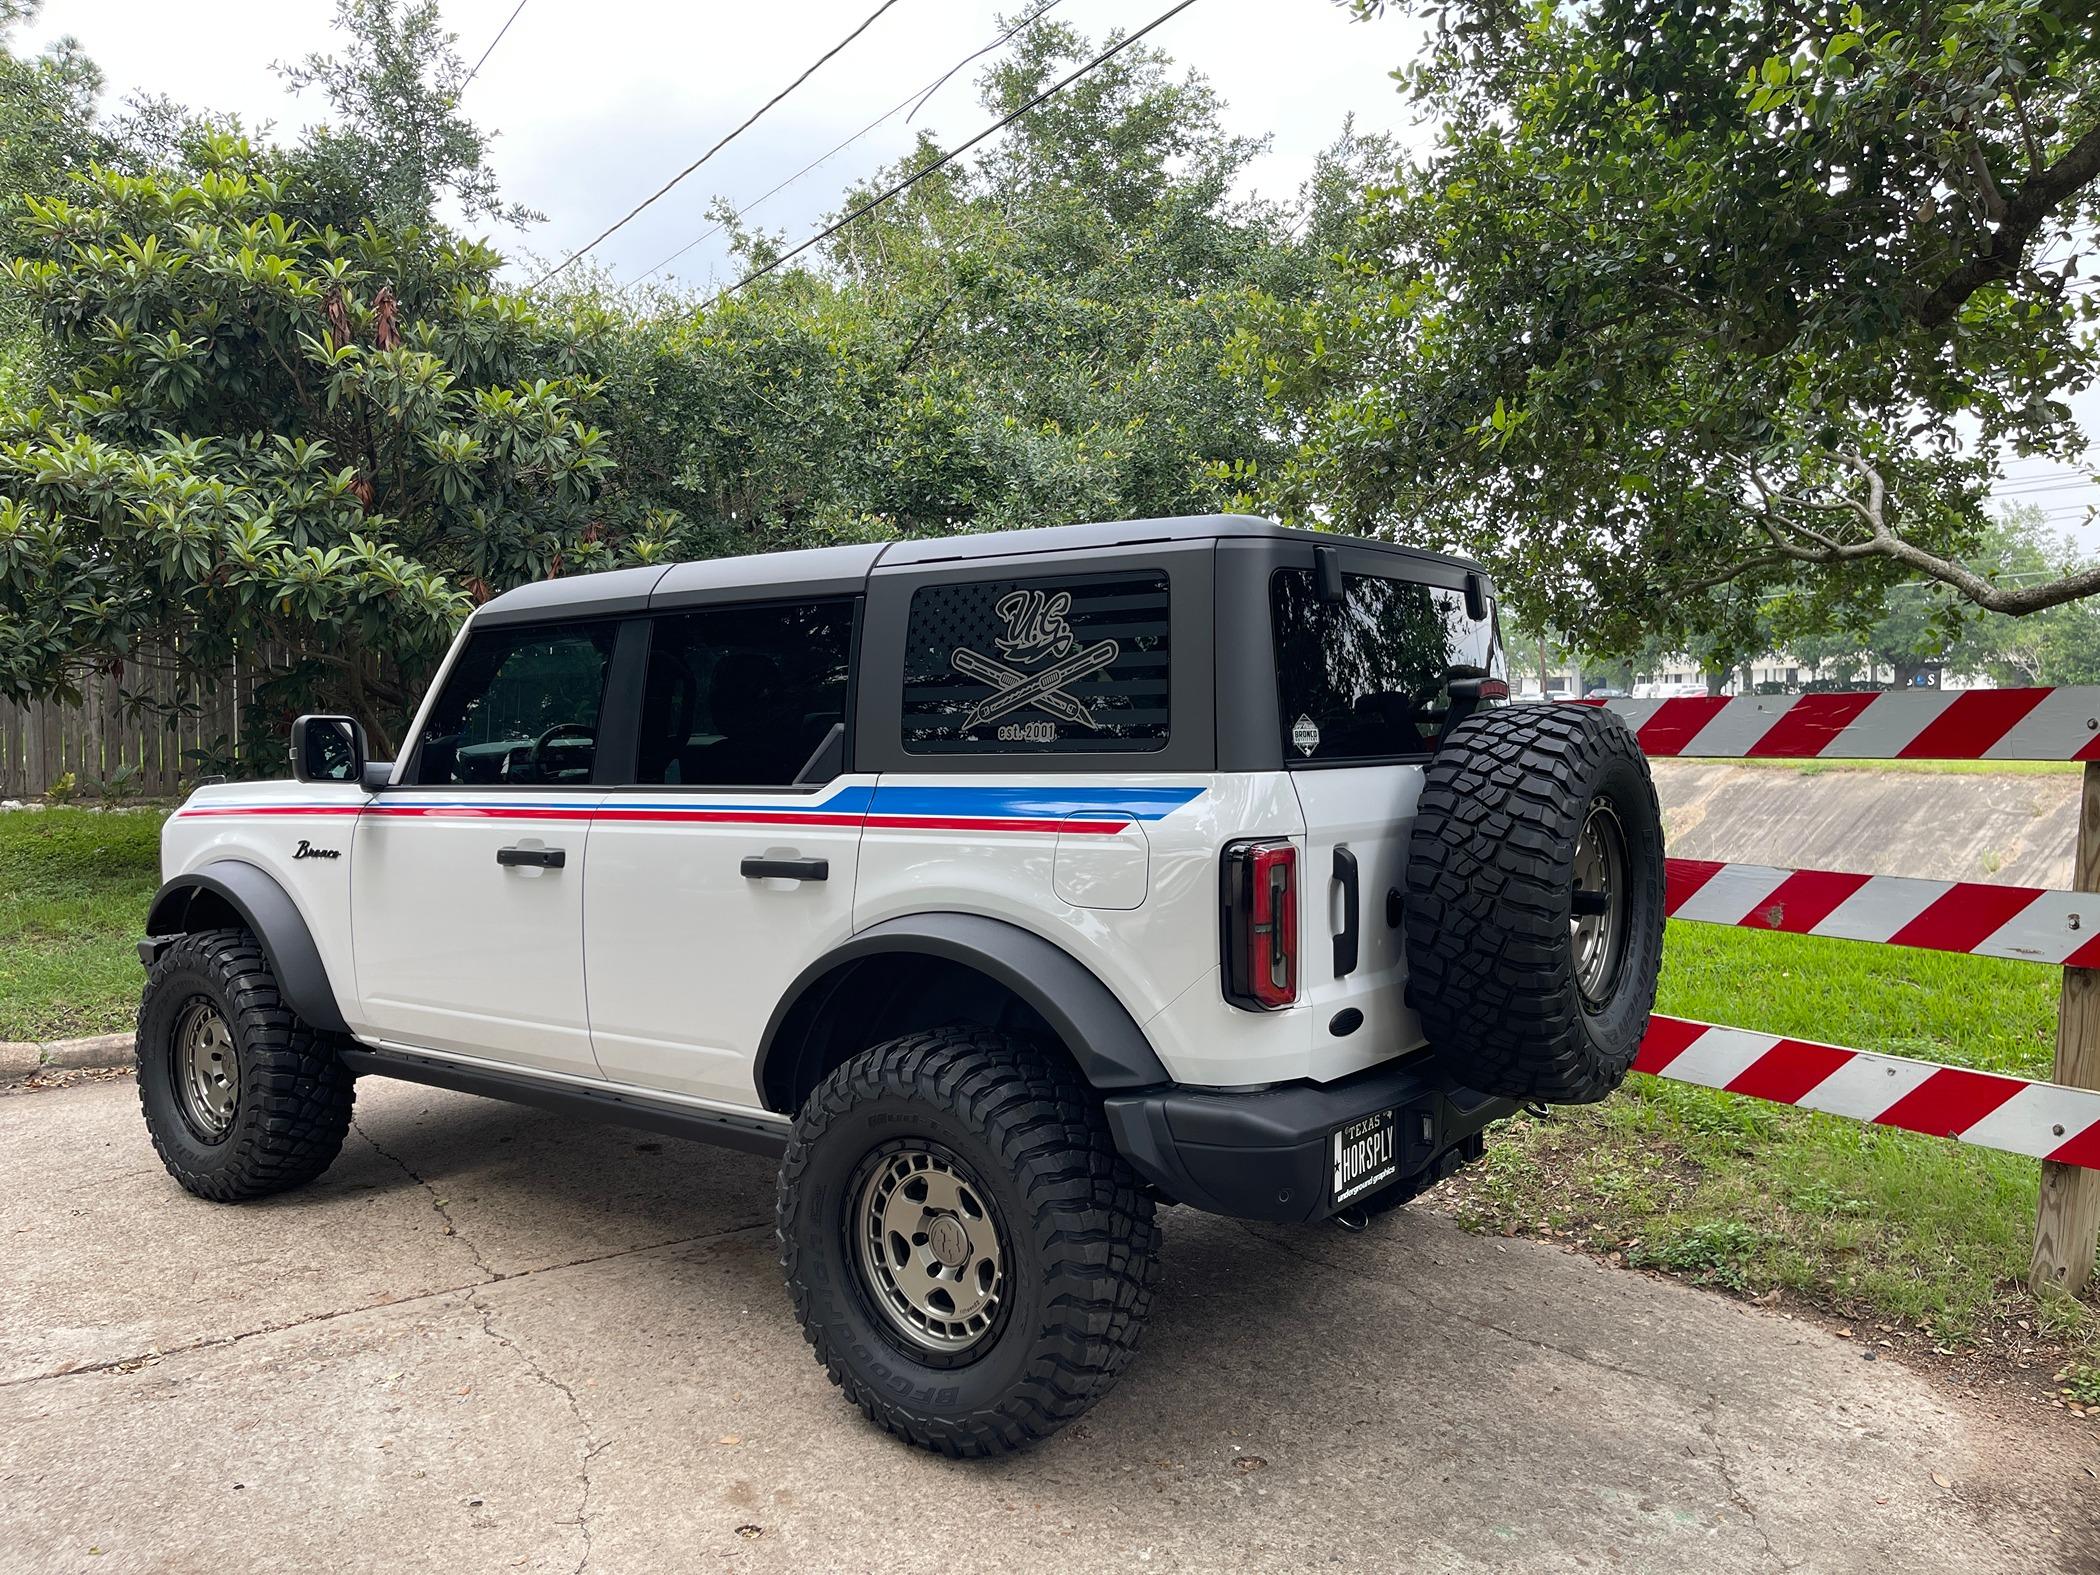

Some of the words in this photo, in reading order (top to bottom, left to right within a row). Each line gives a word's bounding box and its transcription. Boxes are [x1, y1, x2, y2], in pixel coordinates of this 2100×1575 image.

[1295, 730, 1318, 738] BRONCO
[292, 840, 342, 859] Bronco
[1349, 1114, 1381, 1140] TEXAS
[1343, 1125, 1394, 1183] HORSPLY
[1338, 1175, 1373, 1203] underground
[1372, 1165, 1396, 1185] graphics
